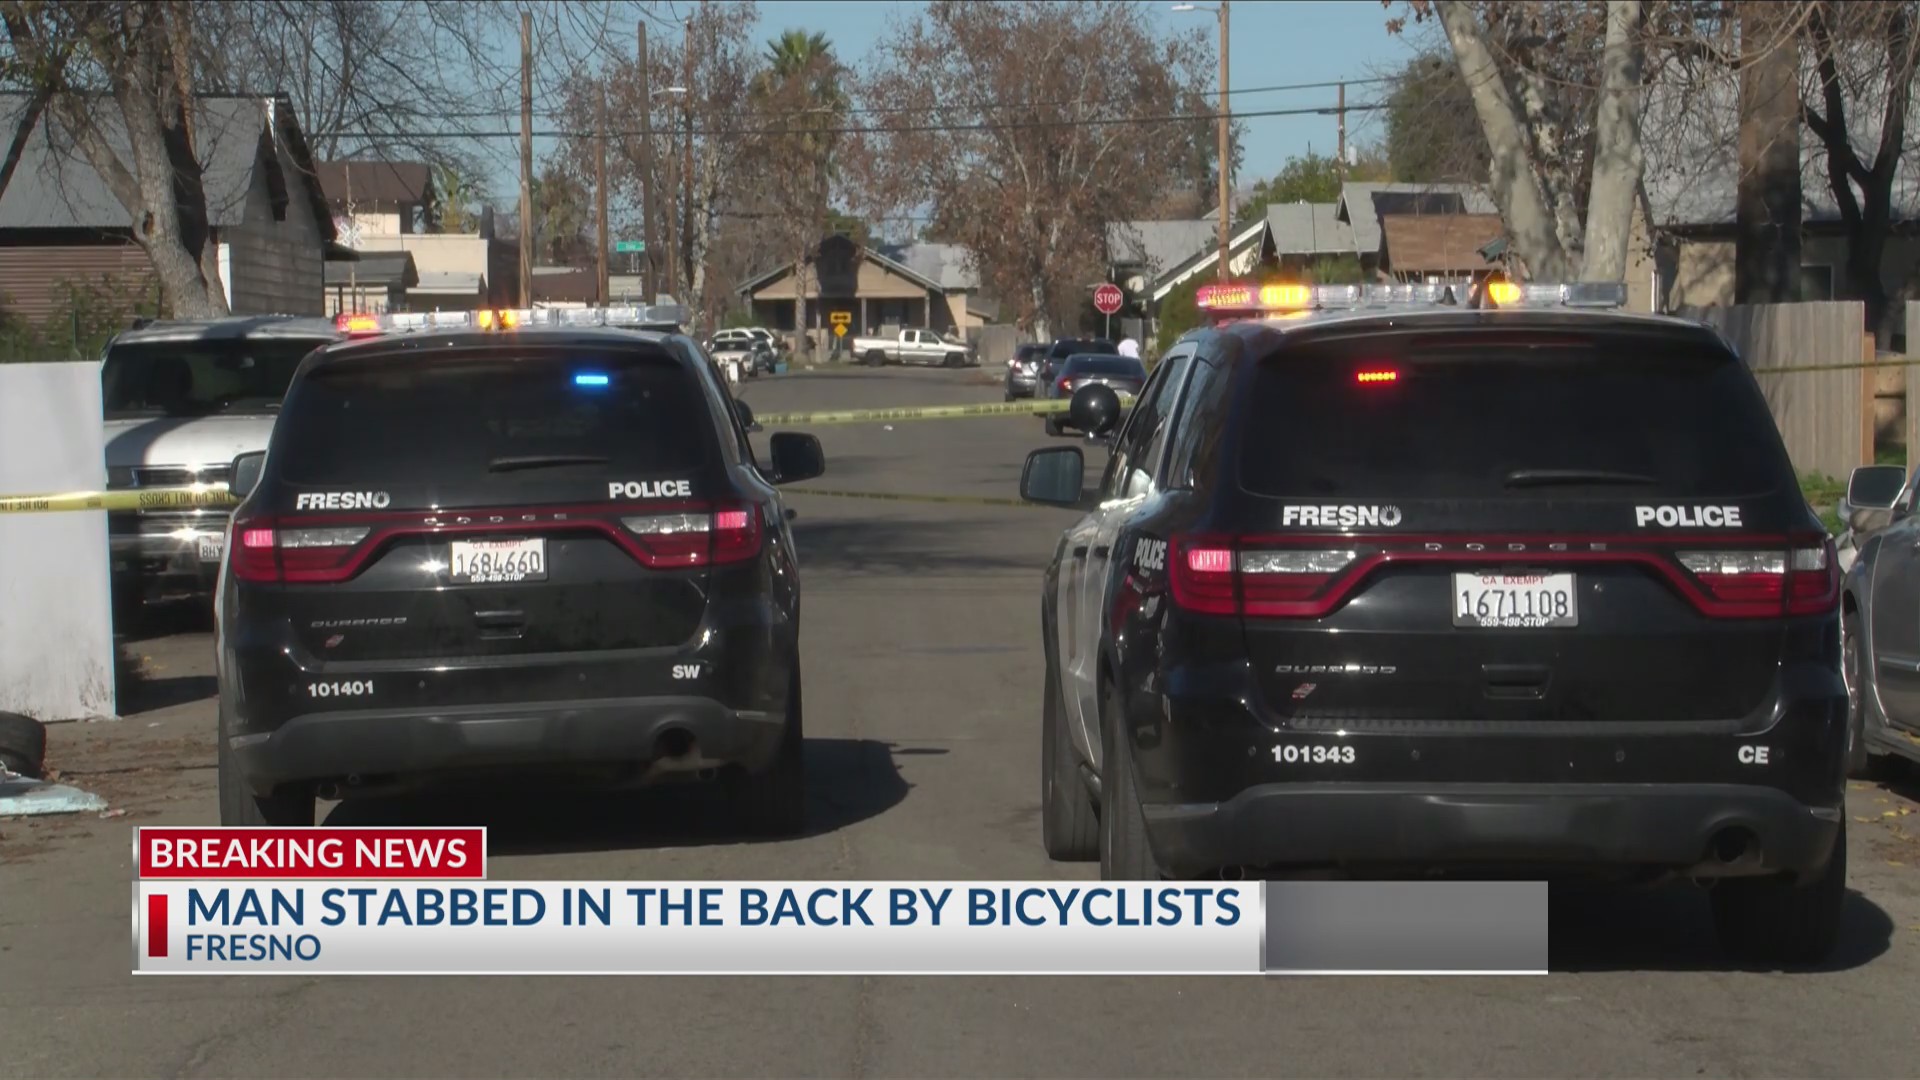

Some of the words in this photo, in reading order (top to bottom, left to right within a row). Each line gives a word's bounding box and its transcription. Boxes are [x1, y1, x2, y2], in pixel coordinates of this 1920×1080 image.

[1097, 293, 1120, 304] STOP
[609, 480, 691, 499] POLICE
[139, 492, 171, 506] CROSS
[174, 492, 193, 505] NOT
[296, 491, 390, 510] FRESNO
[1283, 505, 1402, 526] FRESNO
[1635, 506, 1742, 527] POLICE
[1133, 538, 1167, 570] POLICE
[1425, 543, 1606, 551] DODGE
[457, 551, 540, 575] 1684660
[1482, 576, 1497, 585] CA
[1503, 575, 1544, 585] EXEMPT
[1462, 590, 1568, 617] 1671108
[311, 617, 407, 627] DURANGO
[1481, 617, 1548, 627] 559-498-STOP
[672, 665, 700, 679] SW
[308, 680, 374, 697] 101401
[1271, 745, 1356, 763] 101343
[1738, 746, 1769, 764] CE
